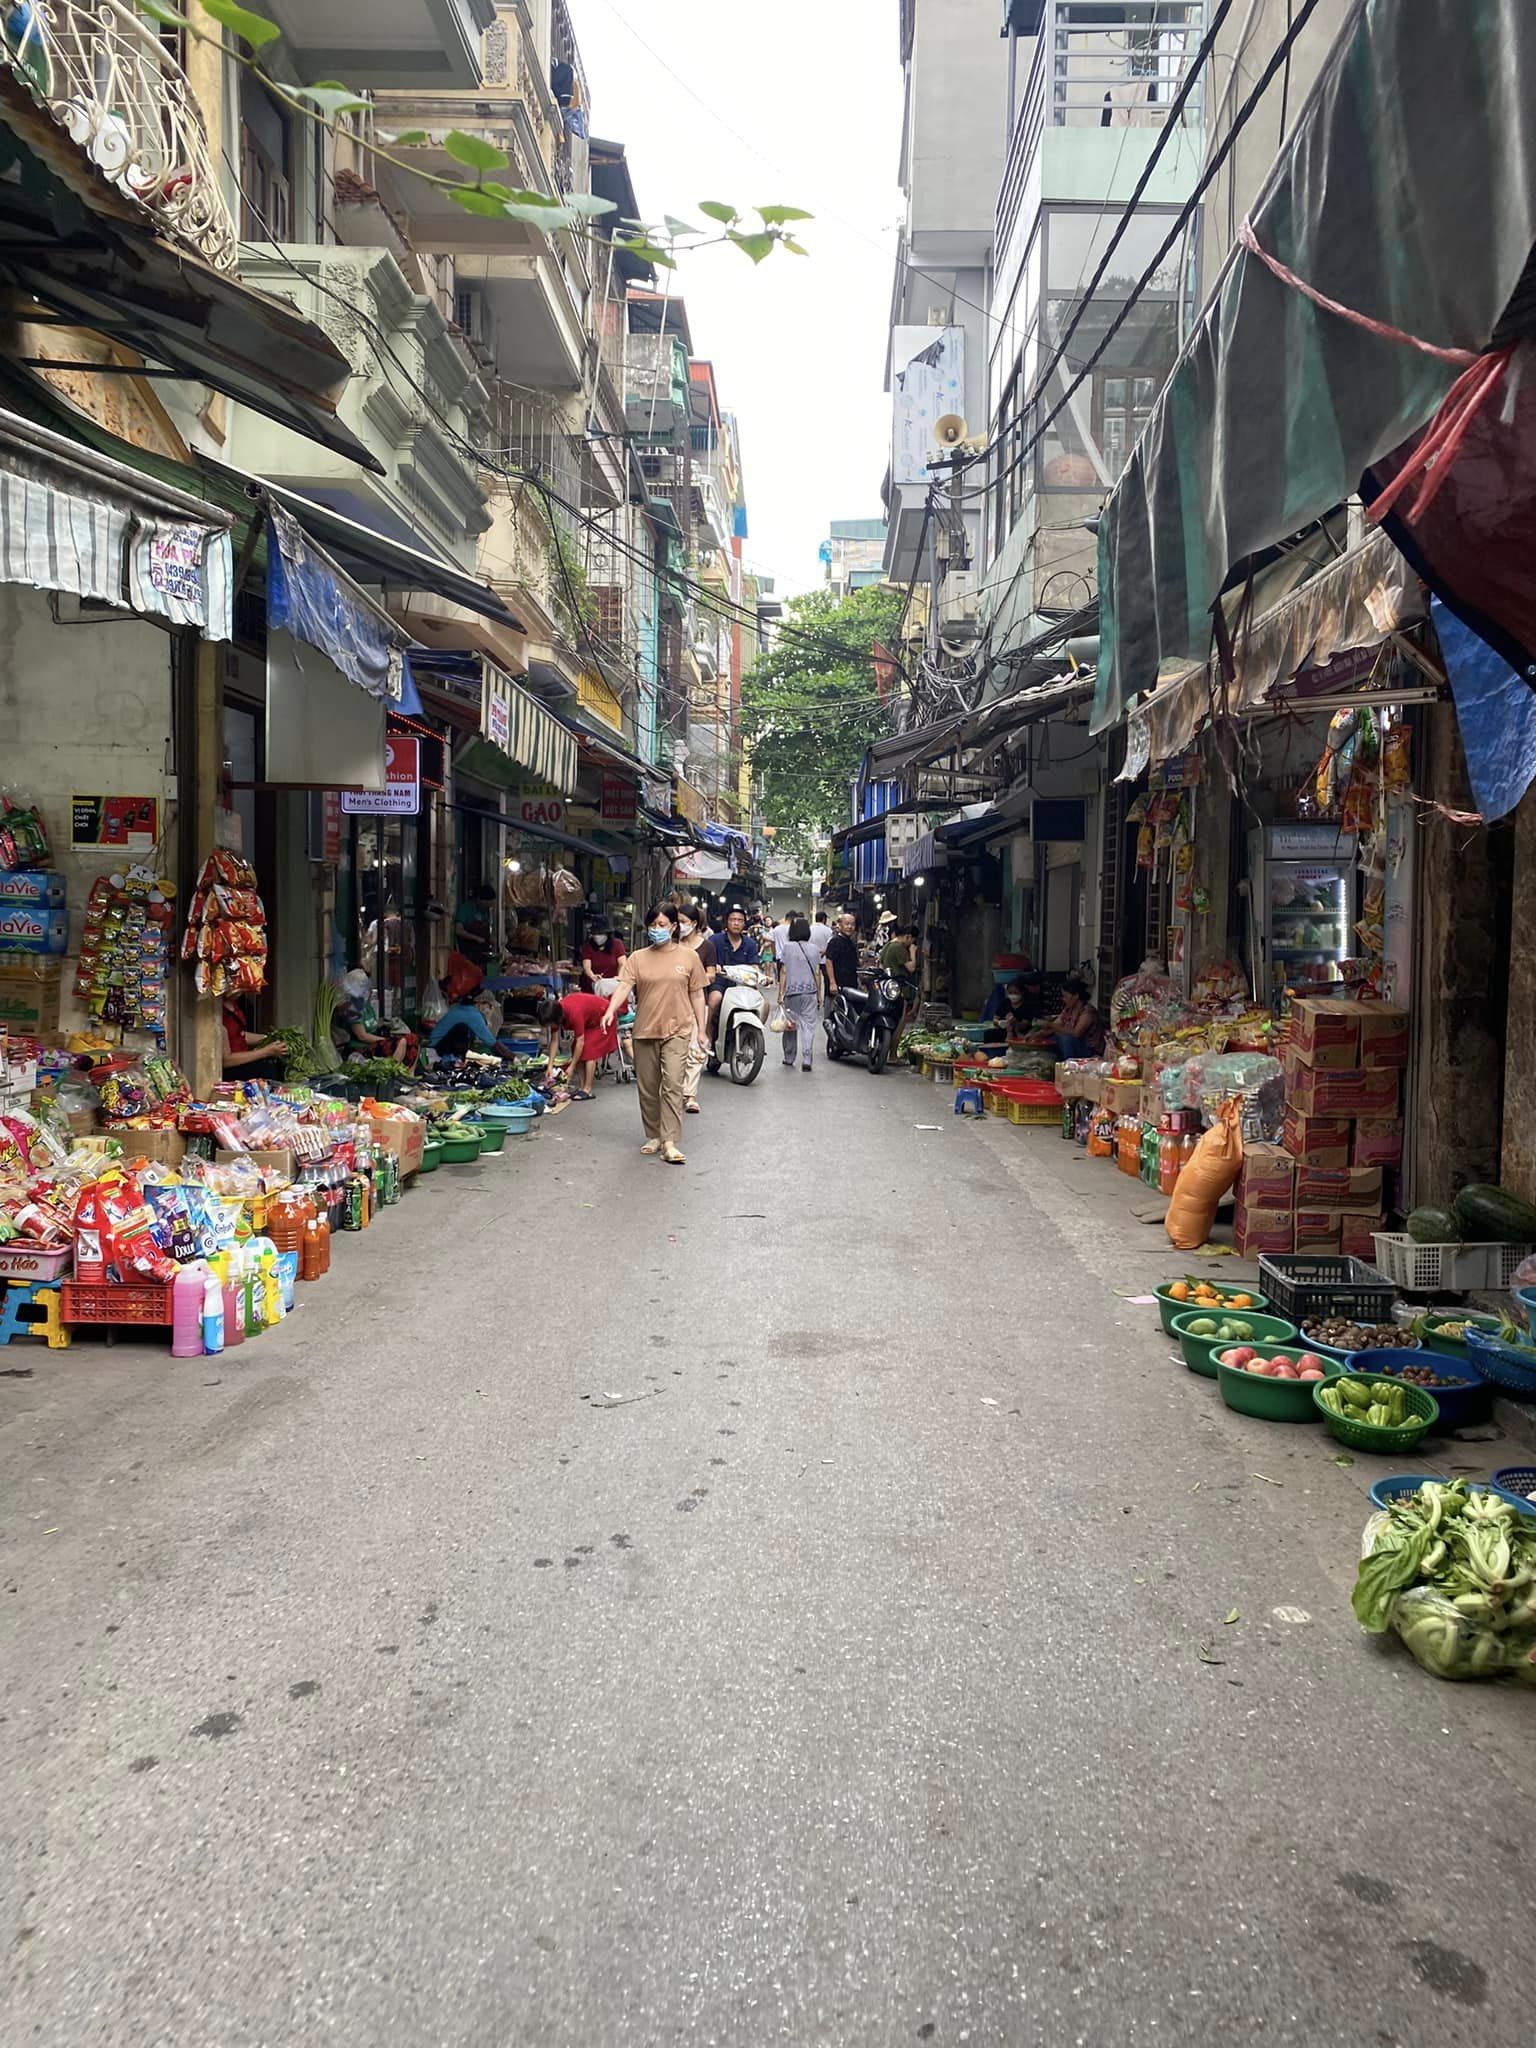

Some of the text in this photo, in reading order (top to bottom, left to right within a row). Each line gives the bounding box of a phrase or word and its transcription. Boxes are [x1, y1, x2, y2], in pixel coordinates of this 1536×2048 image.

[394, 788, 411, 797] NAM
[349, 798, 412, 808] Men's Clothing
